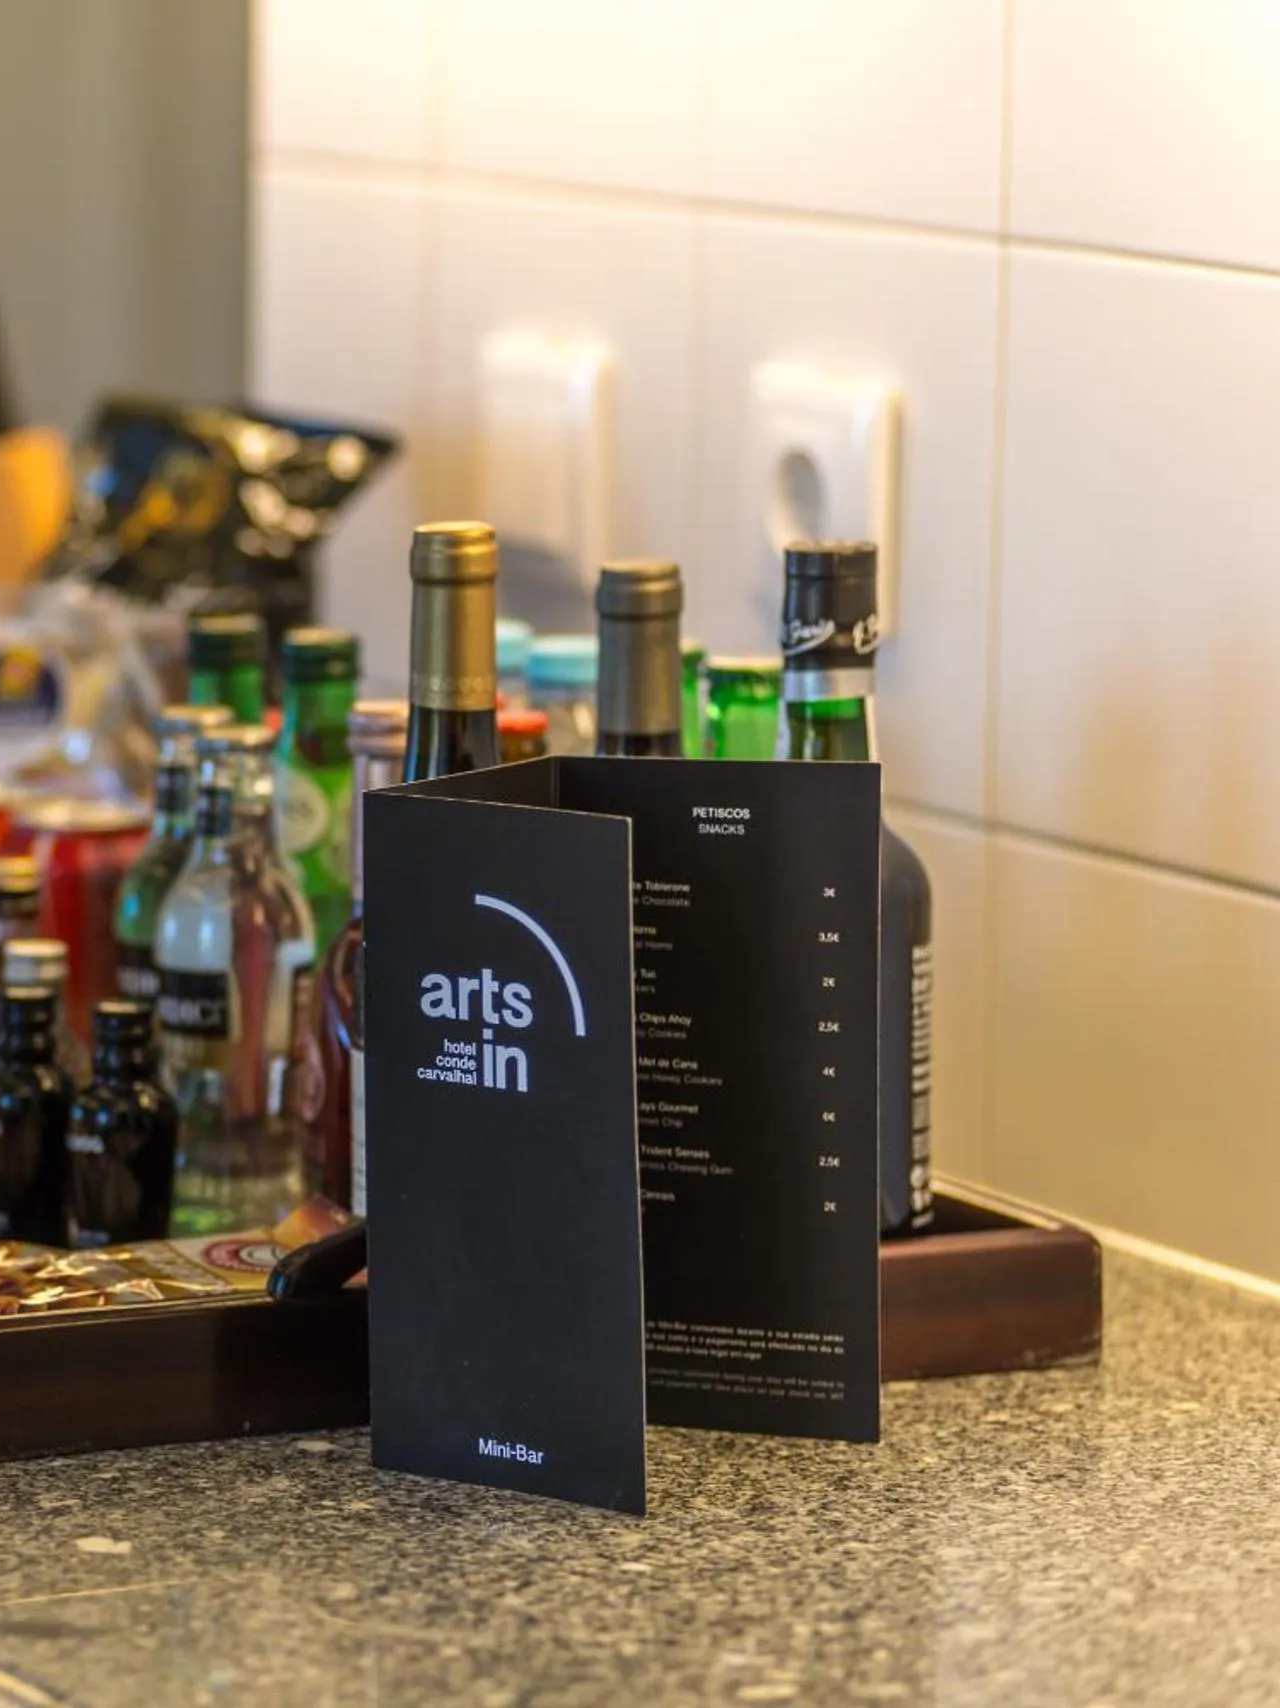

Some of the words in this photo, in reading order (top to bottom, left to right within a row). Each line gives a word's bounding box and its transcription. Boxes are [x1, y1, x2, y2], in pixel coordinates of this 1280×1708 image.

[692, 806, 751, 820] PETISCOS
[699, 823, 745, 836] SNACKS
[823, 887, 836, 898] 3€
[822, 977, 836, 988] 2€
[420, 967, 533, 1029] arts
[443, 1038, 477, 1056] hotel
[435, 1055, 477, 1071] conde
[482, 1027, 528, 1093] in
[416, 1067, 478, 1086] carvalhal
[822, 1066, 836, 1078] 4€
[478, 1437, 545, 1465] Mini-Bar
